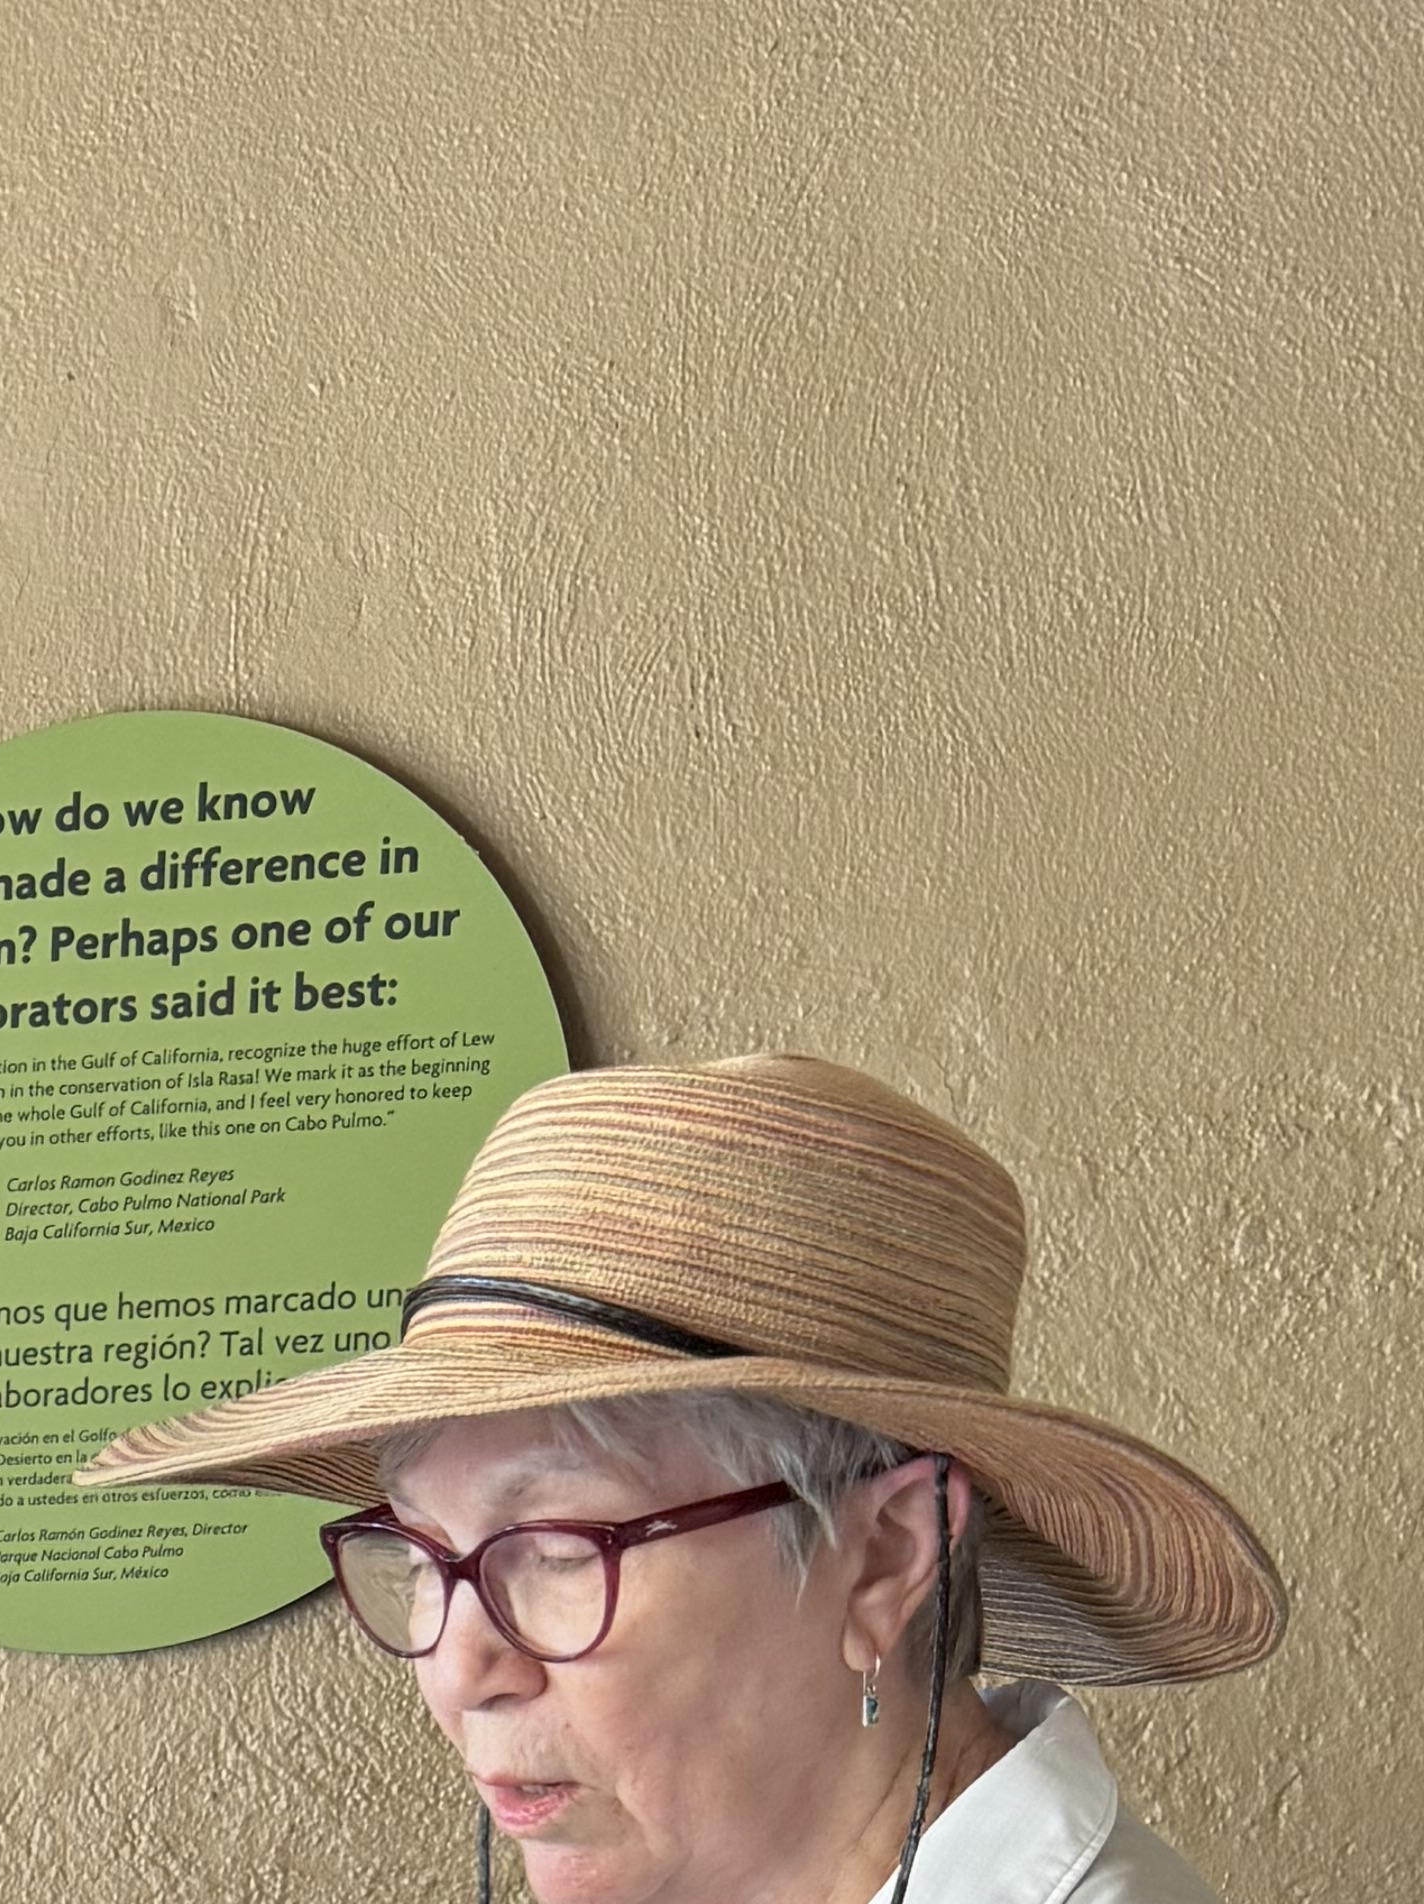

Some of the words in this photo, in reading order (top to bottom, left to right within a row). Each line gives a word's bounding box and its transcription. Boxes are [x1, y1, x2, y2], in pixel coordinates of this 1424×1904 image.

[55, 791, 110, 833] do
[123, 797, 184, 828] we
[197, 781, 316, 822] know
[103, 866, 127, 894] a
[140, 845, 367, 891] difference
[379, 836, 419, 875] in
[50, 917, 218, 967] Perhaps
[231, 919, 312, 950] one
[324, 900, 375, 944] of
[384, 909, 461, 940] our
[150, 975, 236, 1021] said
[249, 976, 282, 1014] it
[294, 970, 398, 1012] best:
[30, 1134, 45, 1146] in
[48, 1128, 93, 1145] other
[96, 1124, 155, 1143] efforts,
[159, 1122, 187, 1139] like
[191, 1120, 221, 1137] this
[225, 1122, 256, 1135] one
[259, 1121, 281, 1134] on
[285, 1114, 328, 1132] Cabo
[6, 1175, 57, 1193] Carlos
[60, 1174, 116, 1190] Ramon
[119, 1169, 185, 1187] Godinez
[188, 1168, 235, 1187] Reyes
[4, 1226, 39, 1245] Baja
[42, 1221, 121, 1240] California
[123, 1220, 153, 1237] Sur,
[157, 1219, 215, 1234] Mexico
[54, 1302, 108, 1332] que
[117, 1291, 215, 1320] hemos
[225, 1280, 357, 1315] marcado
[367, 1288, 402, 1309] un
[103, 1330, 211, 1370] región?
[219, 1326, 263, 1358] Tal
[275, 1333, 324, 1355] vez
[334, 1331, 391, 1353] uno
